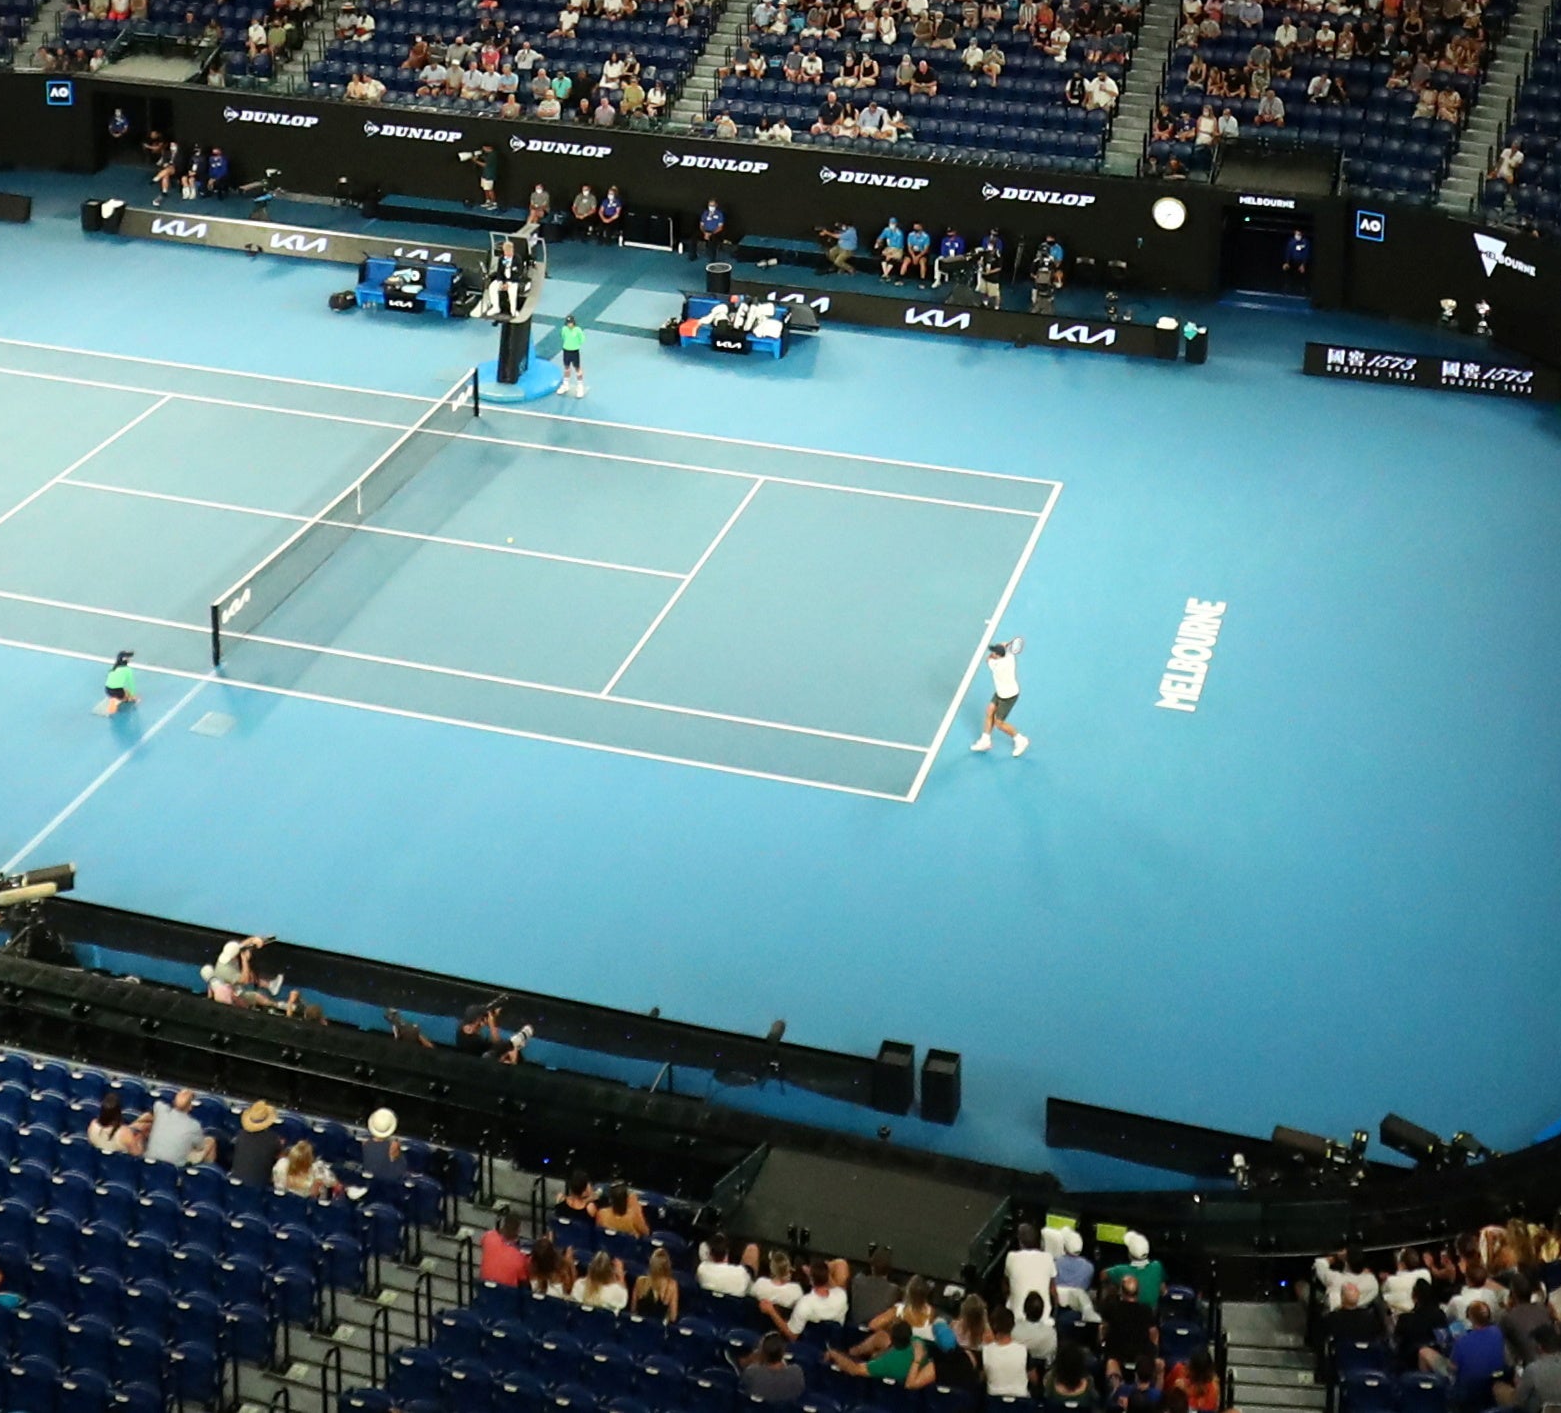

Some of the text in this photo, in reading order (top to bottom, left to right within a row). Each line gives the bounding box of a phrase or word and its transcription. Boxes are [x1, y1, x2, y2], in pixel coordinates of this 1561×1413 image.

[50, 87, 70, 98] AO
[240, 109, 319, 129] DUNLOP
[380, 124, 463, 144] DUNLOP
[526, 139, 612, 159] DUNLOP
[680, 155, 769, 174] DUNLOP
[838, 170, 930, 191] DUNLOP
[1000, 186, 1095, 208] DUNLOP
[1239, 196, 1296, 209] MELBOURNE
[151, 218, 207, 239] KIA
[1360, 218, 1381, 232] AO
[270, 232, 327, 253] KIA
[904, 306, 971, 329] KIA
[1048, 322, 1116, 346] KIA
[1154, 596, 1227, 713] MELBOURNE
